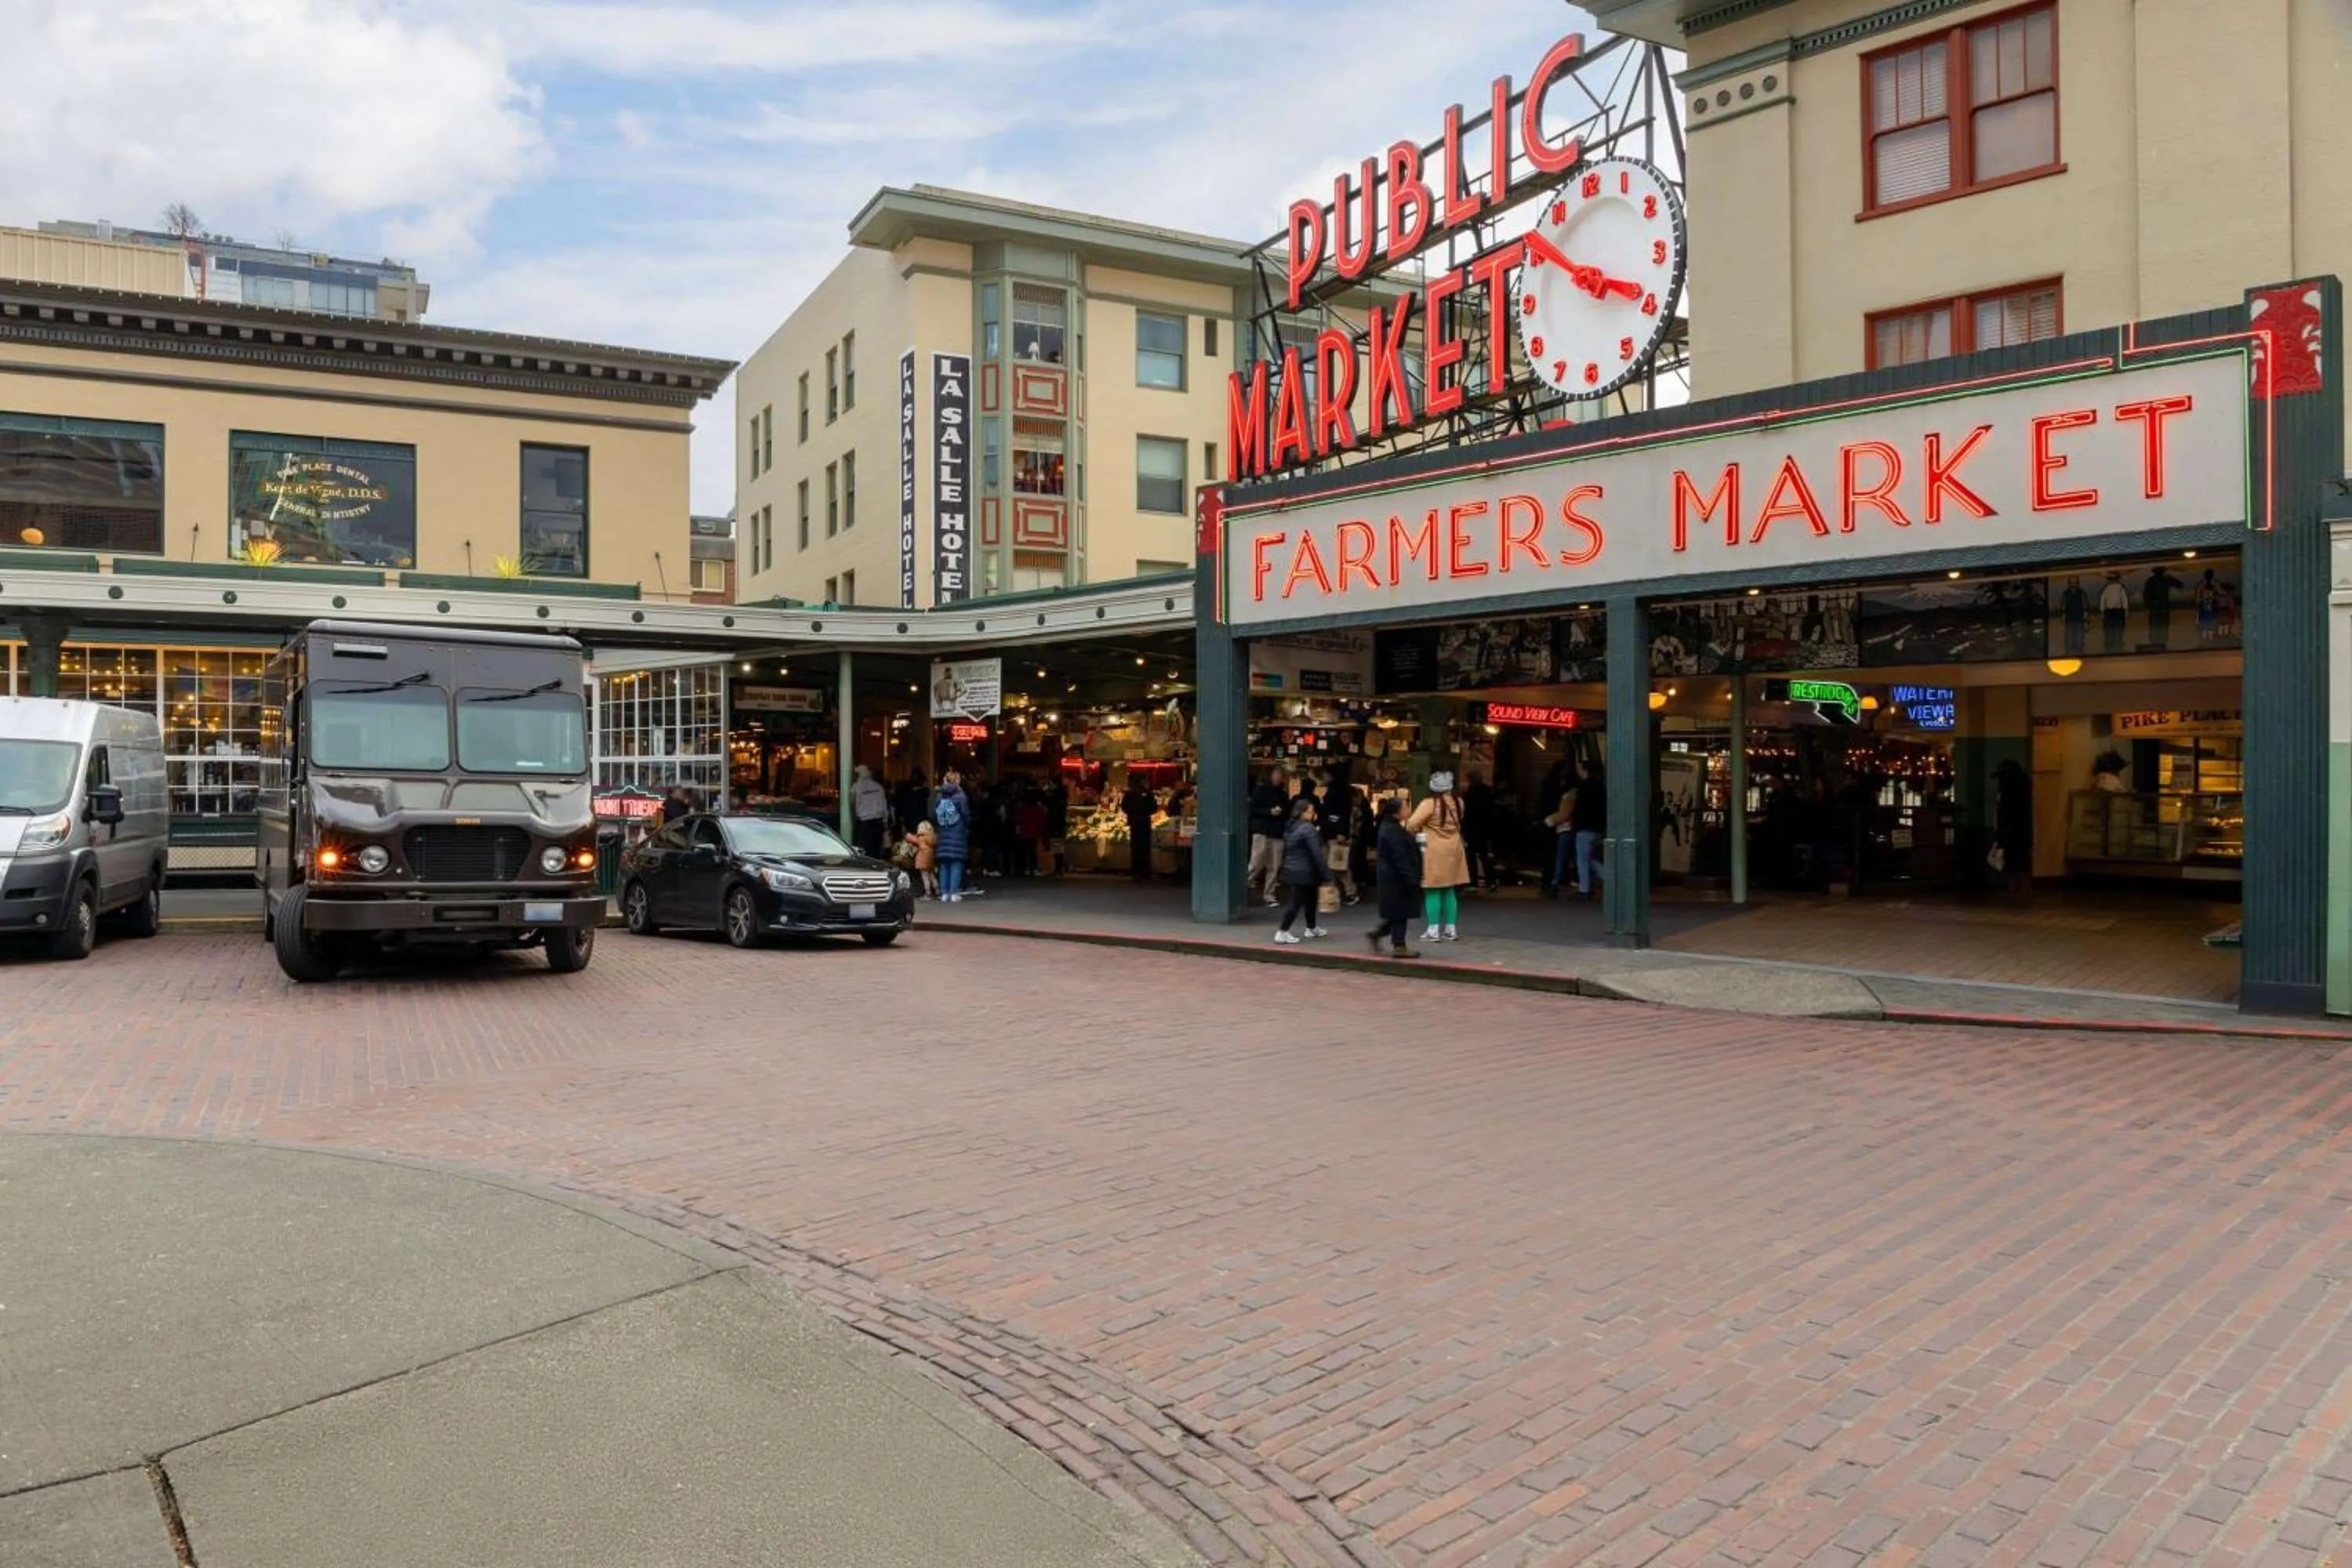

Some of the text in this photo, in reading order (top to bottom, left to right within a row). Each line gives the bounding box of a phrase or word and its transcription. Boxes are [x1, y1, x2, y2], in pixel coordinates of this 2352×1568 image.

[1288, 33, 1584, 311] PUBLIC
[1620, 171, 1629, 194] 1
[1582, 173, 1601, 198] 12
[1552, 201, 1566, 225] 11
[1643, 195, 1657, 219] 2
[1653, 240, 1667, 265] 3
[1523, 295, 1536, 314] 9
[1641, 292, 1657, 316] 4
[1229, 235, 1526, 482] MARKET
[1530, 336, 1544, 358] 8
[1620, 336, 1634, 360] 5
[940, 358, 964, 397] LA
[1554, 361, 1566, 383] 7
[1584, 362, 1599, 383] 6
[940, 407, 964, 503] SALLE
[336, 464, 370, 486] DENTAL
[902, 361, 913, 609] LA SALLE HOTEL
[349, 488, 383, 499] D.D.S.
[1253, 394, 2194, 602] FARMERS MARKET
[1487, 703, 1522, 719] SOUND
[1525, 706, 1548, 720] VIEW
[2121, 710, 2170, 729] PIKE
